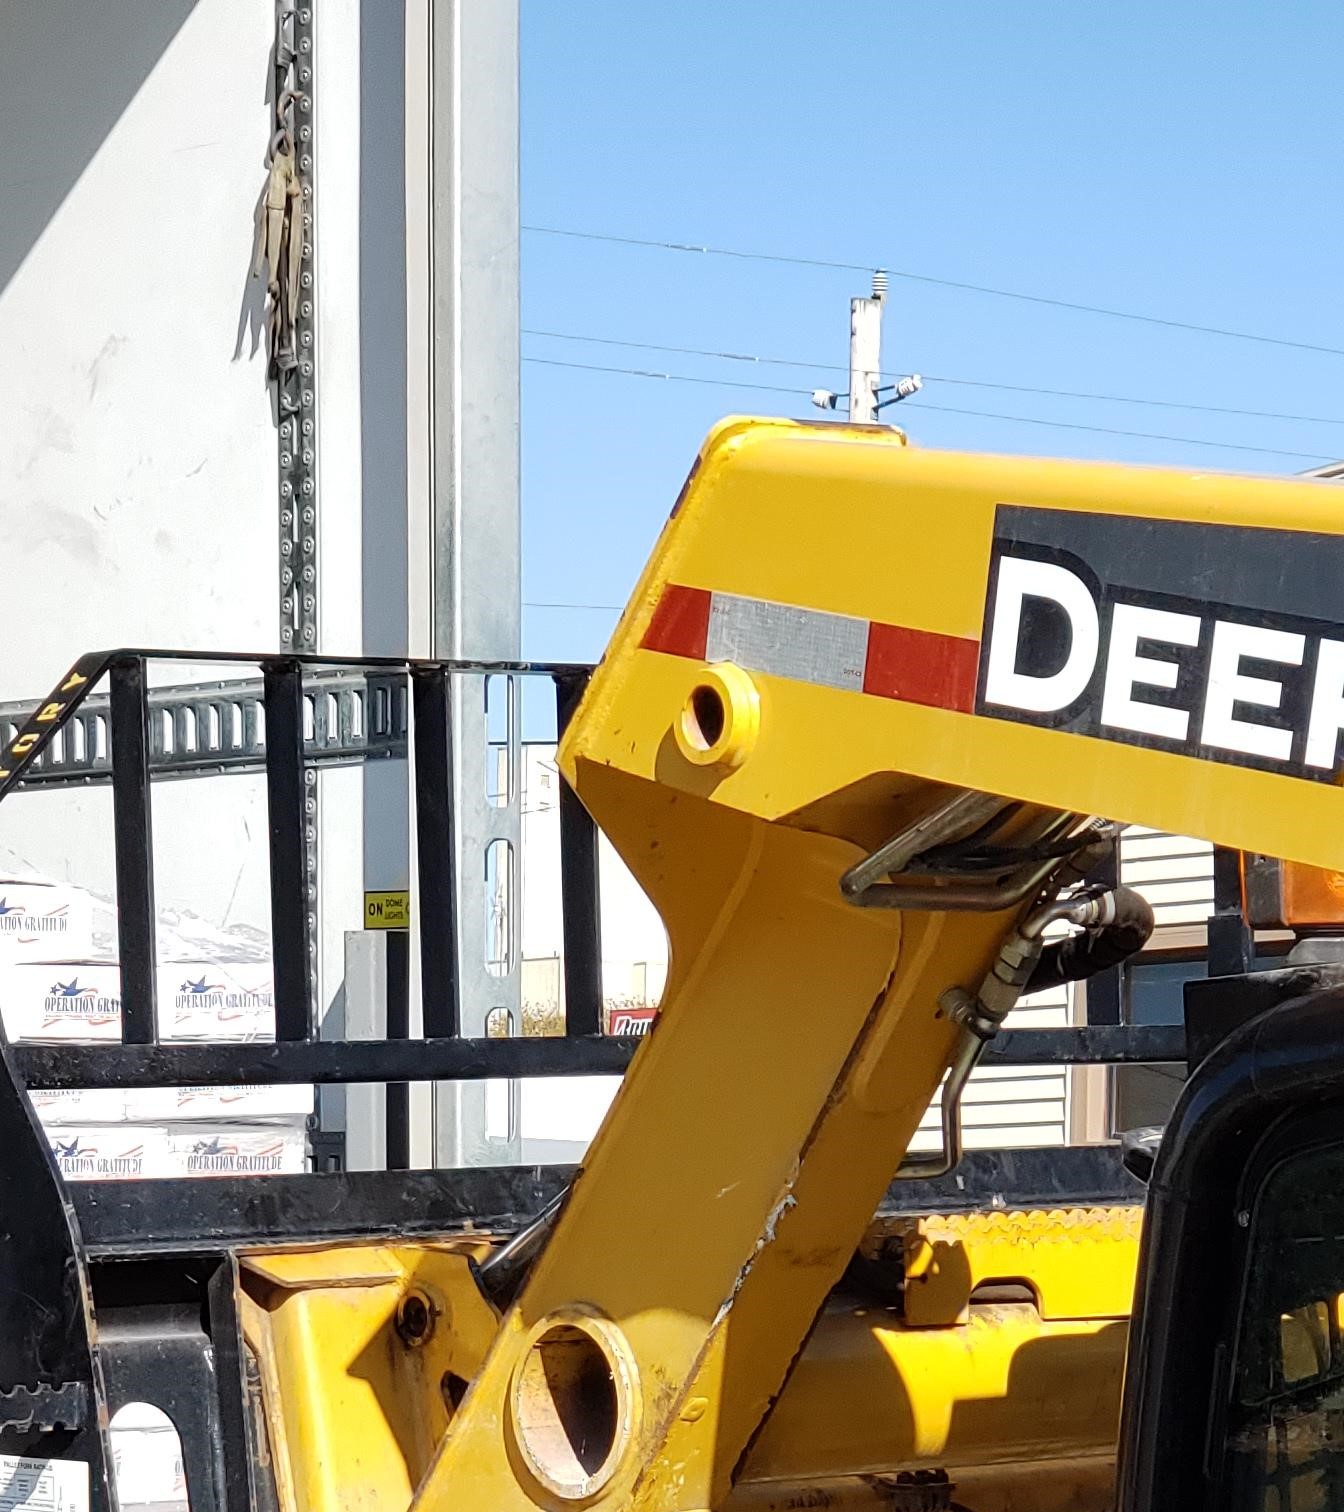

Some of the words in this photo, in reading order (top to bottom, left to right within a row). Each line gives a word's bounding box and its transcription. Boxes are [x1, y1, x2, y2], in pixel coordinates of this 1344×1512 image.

[368, 902, 383, 916] ON
[44, 997, 94, 1013] OPERATION
[59, 1158, 94, 1174] RATION
